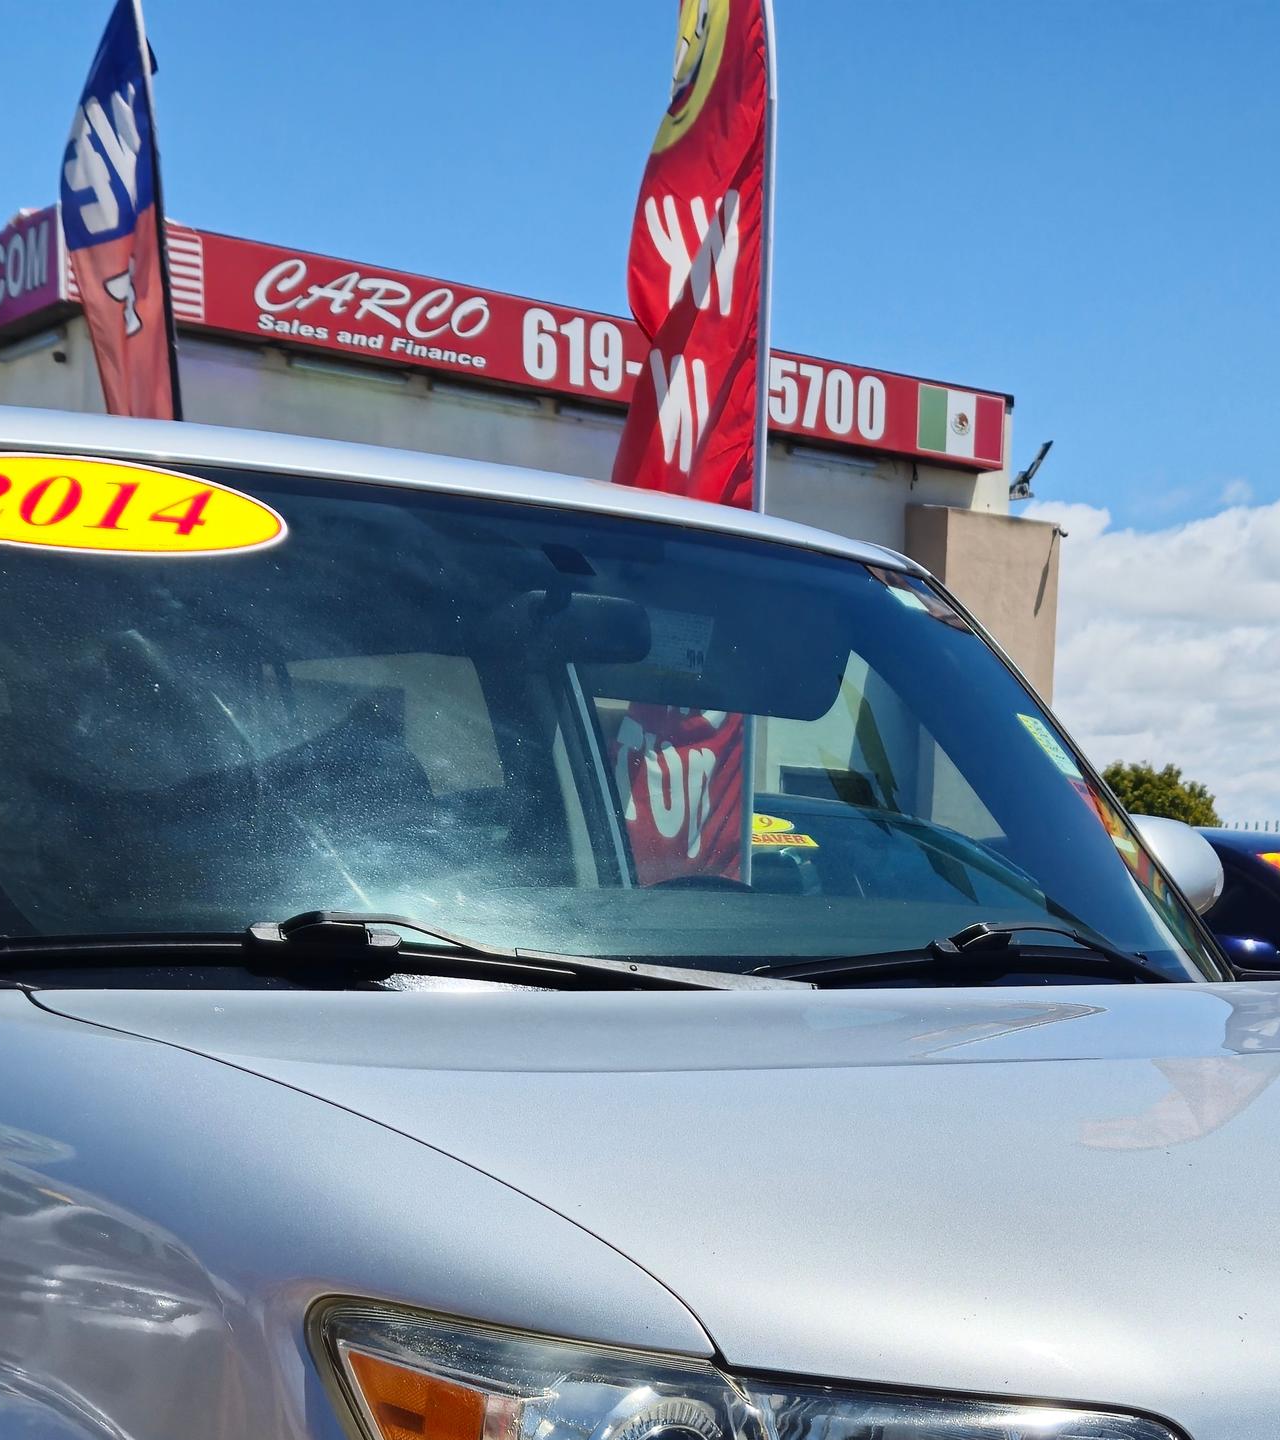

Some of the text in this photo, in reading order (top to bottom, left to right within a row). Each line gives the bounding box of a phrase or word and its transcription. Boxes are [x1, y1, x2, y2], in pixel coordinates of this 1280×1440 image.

[255, 259, 490, 339] CARCO
[257, 313, 487, 369] Sales and Finance
